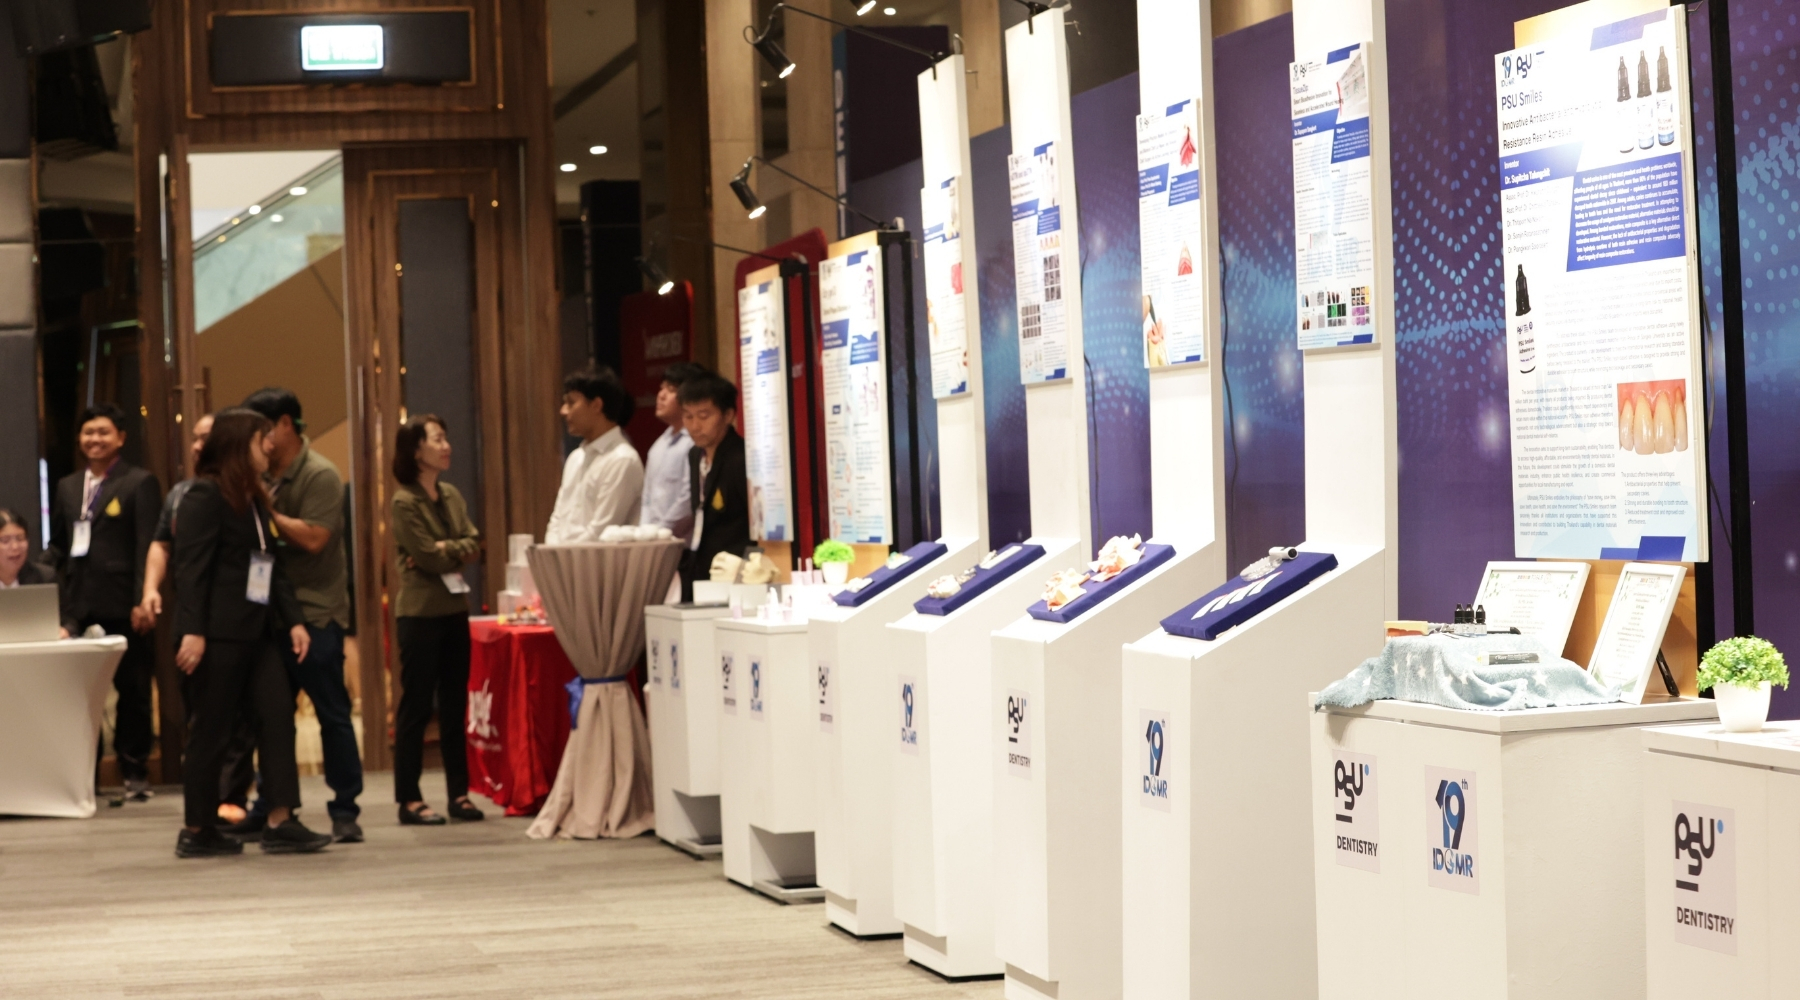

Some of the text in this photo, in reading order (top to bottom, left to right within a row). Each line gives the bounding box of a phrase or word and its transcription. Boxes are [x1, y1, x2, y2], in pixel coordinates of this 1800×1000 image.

[1502, 89, 1542, 110] PSU Smiles
[1502, 116, 1528, 131] Innovative
[1503, 136, 1531, 149] Resistance
[1008, 696, 1023, 733] PSU
[1009, 752, 1030, 768] DENTISTRY
[1335, 760, 1363, 810] PSU
[1337, 835, 1378, 857] DENTISTRY
[1675, 813, 1715, 876] PSU
[1677, 906, 1734, 935] DENTISTRY
